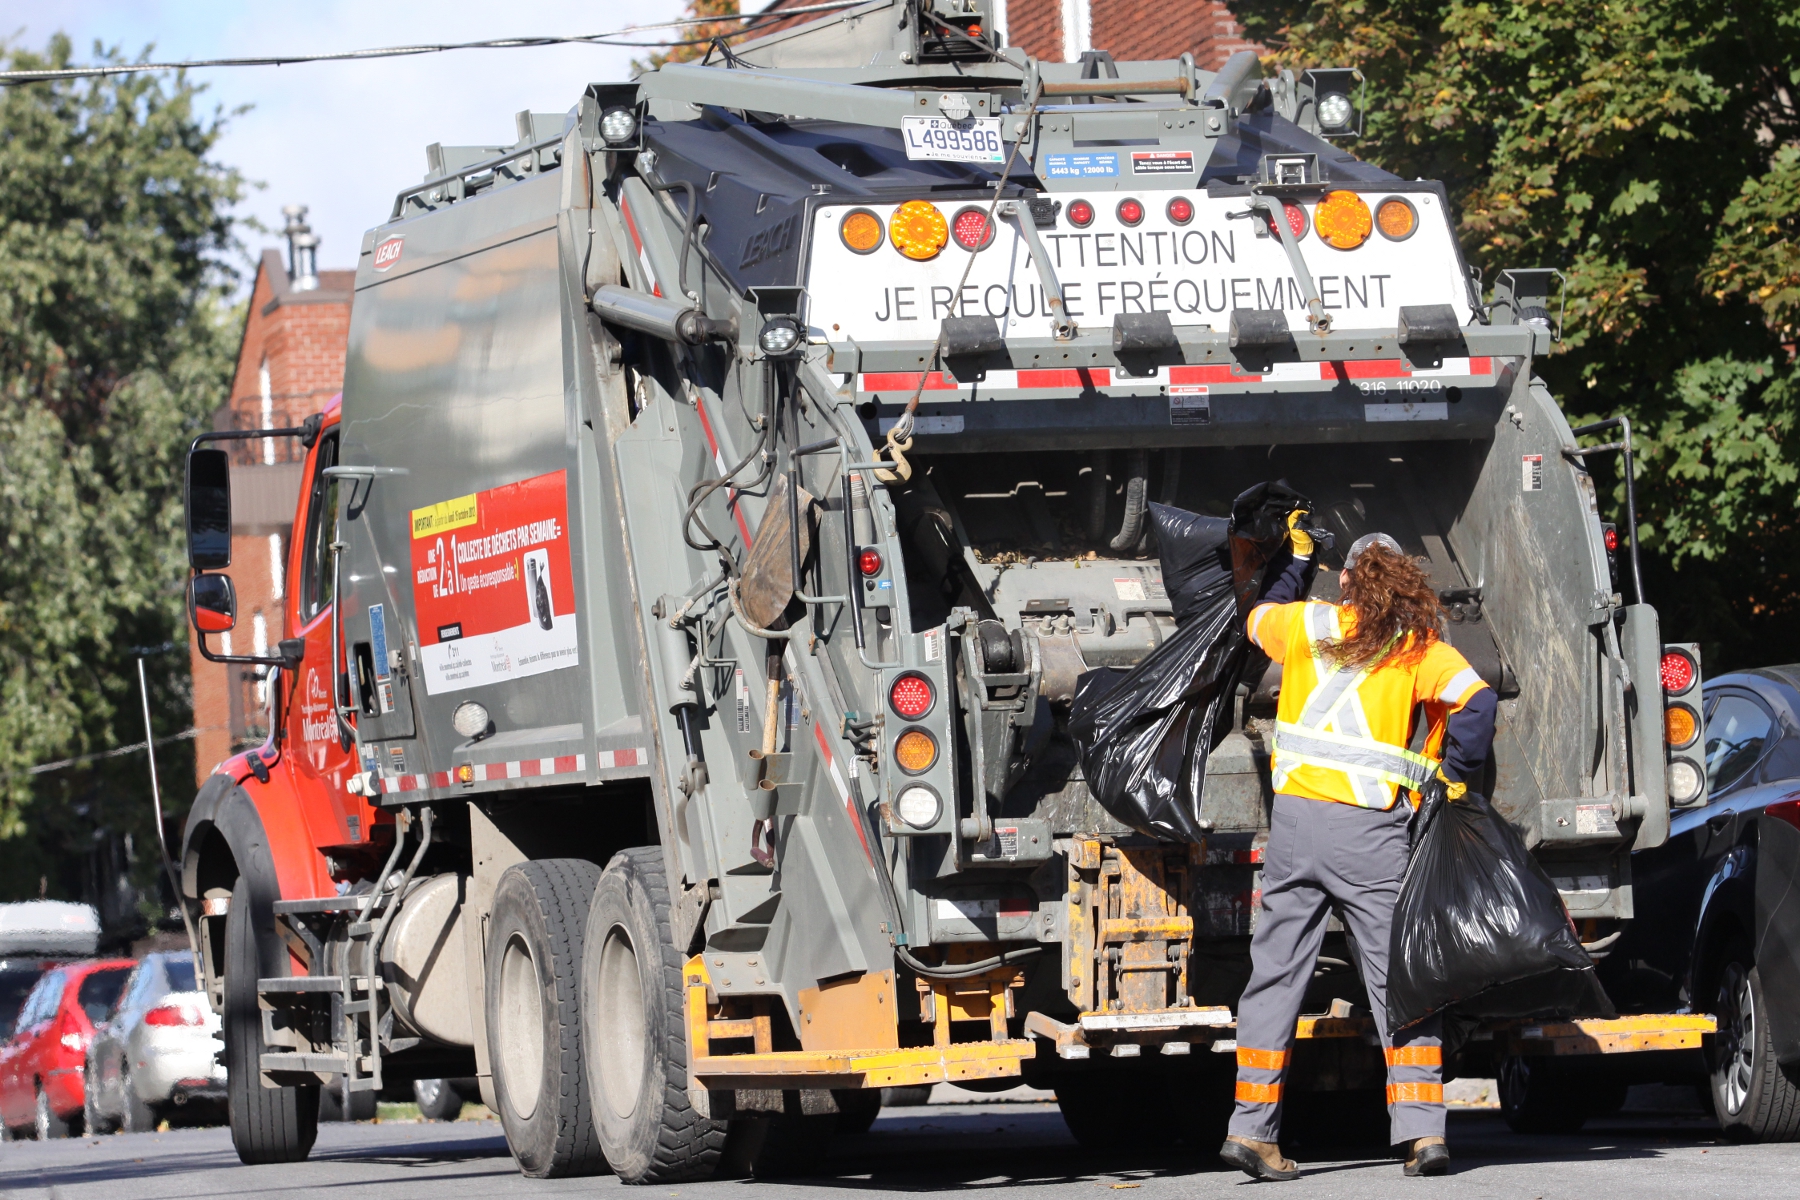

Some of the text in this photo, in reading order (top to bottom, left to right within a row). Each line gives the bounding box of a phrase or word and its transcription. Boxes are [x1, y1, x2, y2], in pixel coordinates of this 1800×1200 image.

[908, 129, 999, 152] L499586
[1051, 167, 1069, 175] 5443
[1070, 167, 1080, 176] kg
[375, 240, 403, 265] LEACH
[739, 212, 799, 270] LEACH
[876, 272, 1391, 322] JE RECULE FRÉQUEMMENT
[1360, 379, 1441, 396] 316 11020
[415, 515, 433, 532] IMPORTANT
[457, 538, 484, 564] COLLECTE
[483, 536, 492, 559] DE
[491, 528, 517, 556] DÉCHETS
[517, 525, 530, 548] PAR
[436, 534, 460, 597] 2 à 1
[302, 714, 331, 742] Montréal
